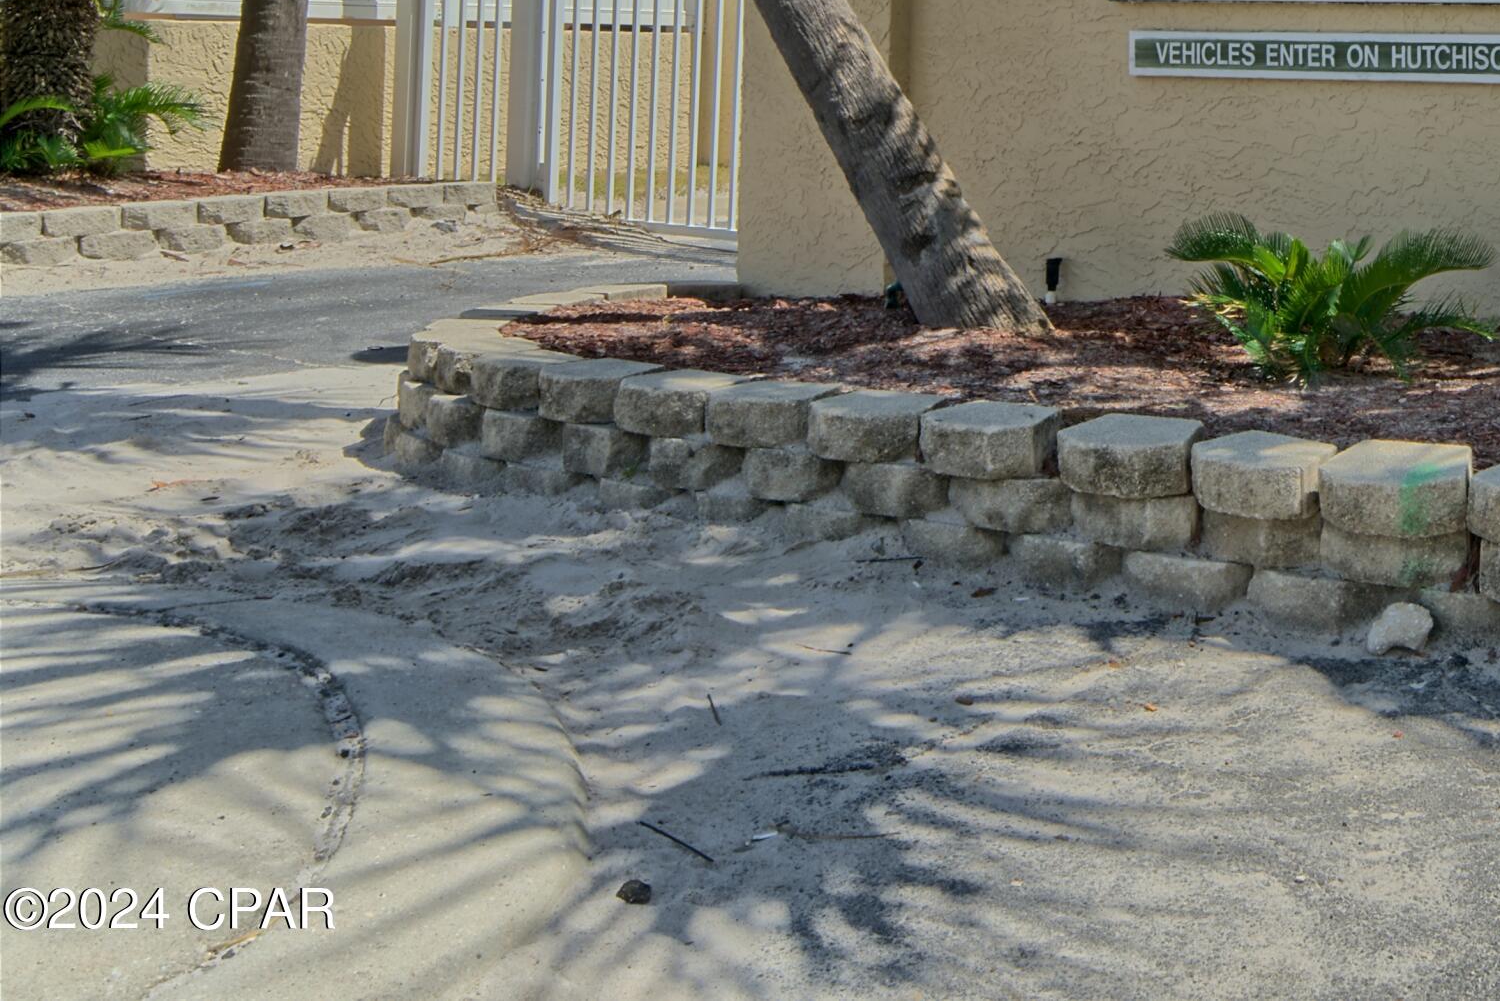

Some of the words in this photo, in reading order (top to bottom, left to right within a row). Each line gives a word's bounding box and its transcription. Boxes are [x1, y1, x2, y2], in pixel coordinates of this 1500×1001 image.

[1155, 42, 1255, 66] VEHICLES
[1266, 44, 1336, 67] ENTER
[1346, 44, 1379, 68] ON
